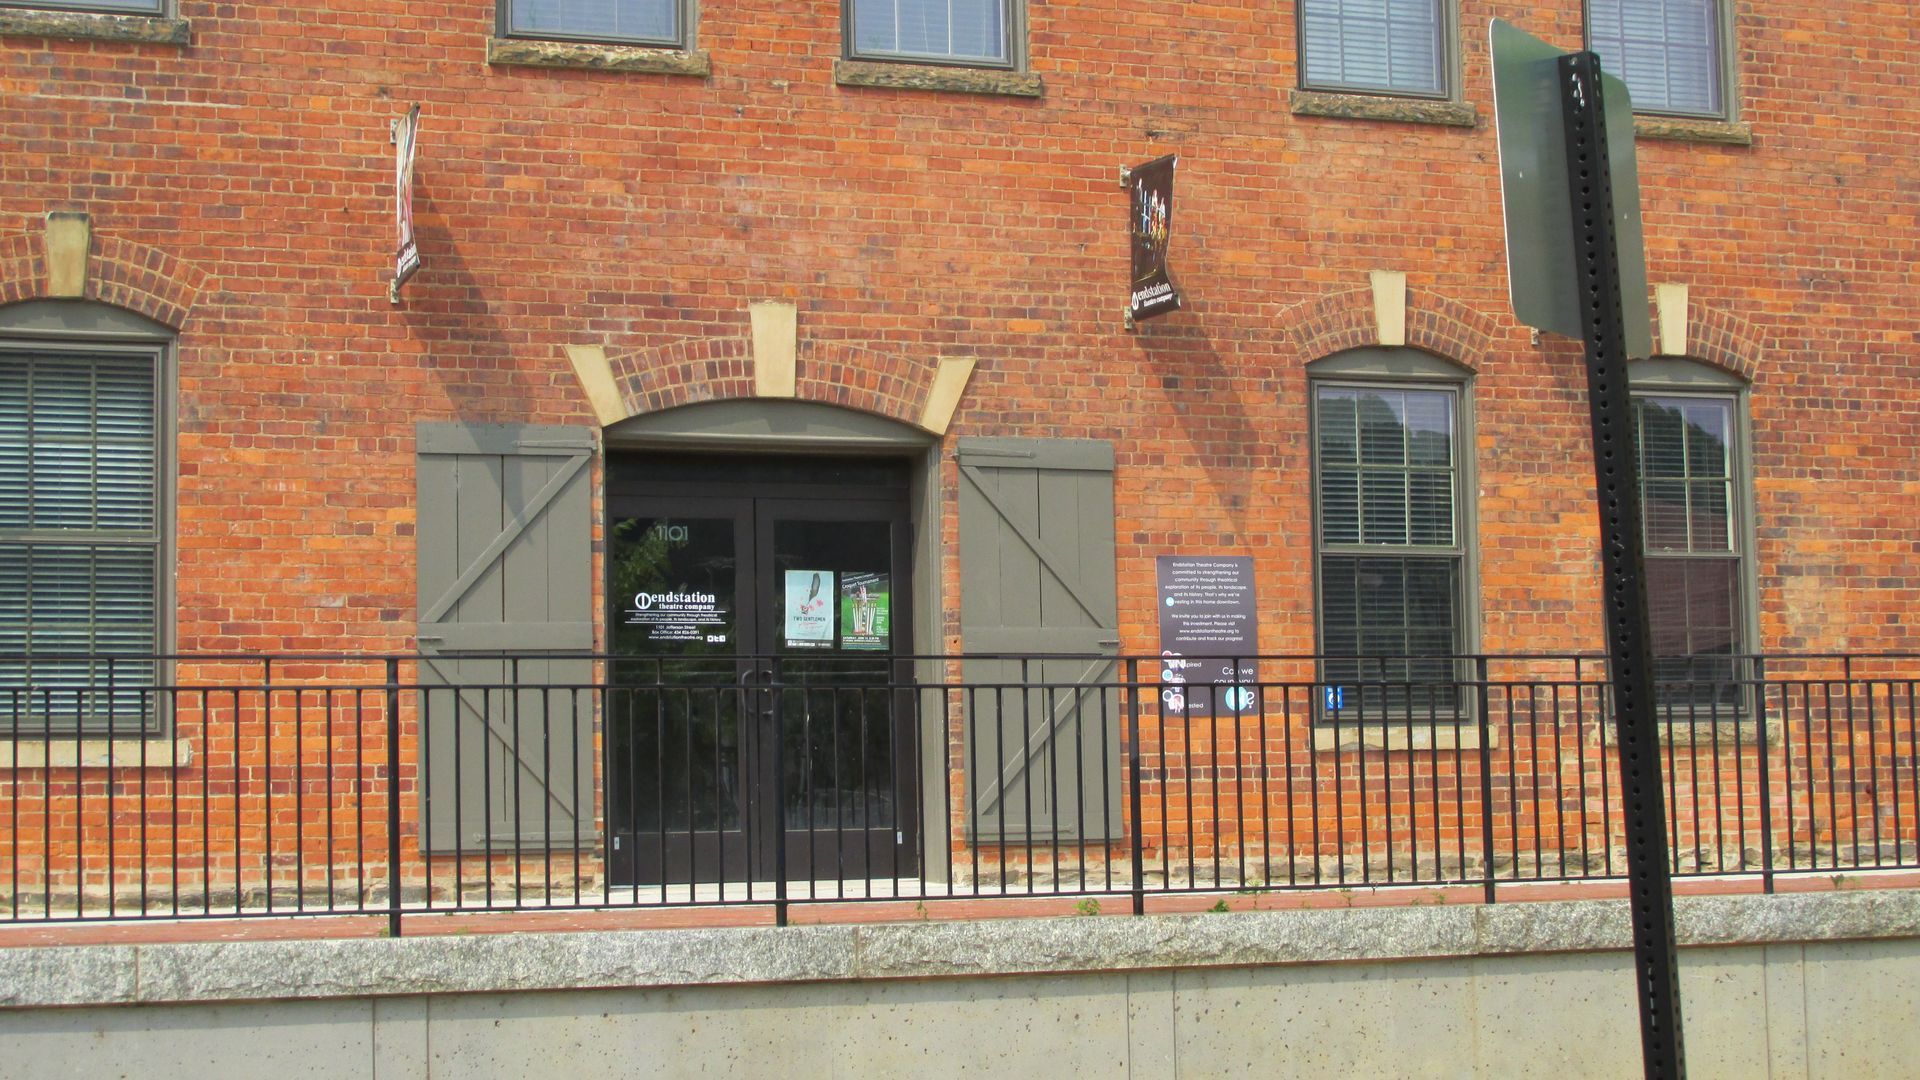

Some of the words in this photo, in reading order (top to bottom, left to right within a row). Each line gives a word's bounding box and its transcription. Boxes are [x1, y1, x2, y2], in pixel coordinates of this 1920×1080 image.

[1138, 282, 1172, 300] endstation
[656, 525, 688, 541] 1101
[652, 592, 715, 602] endstation
